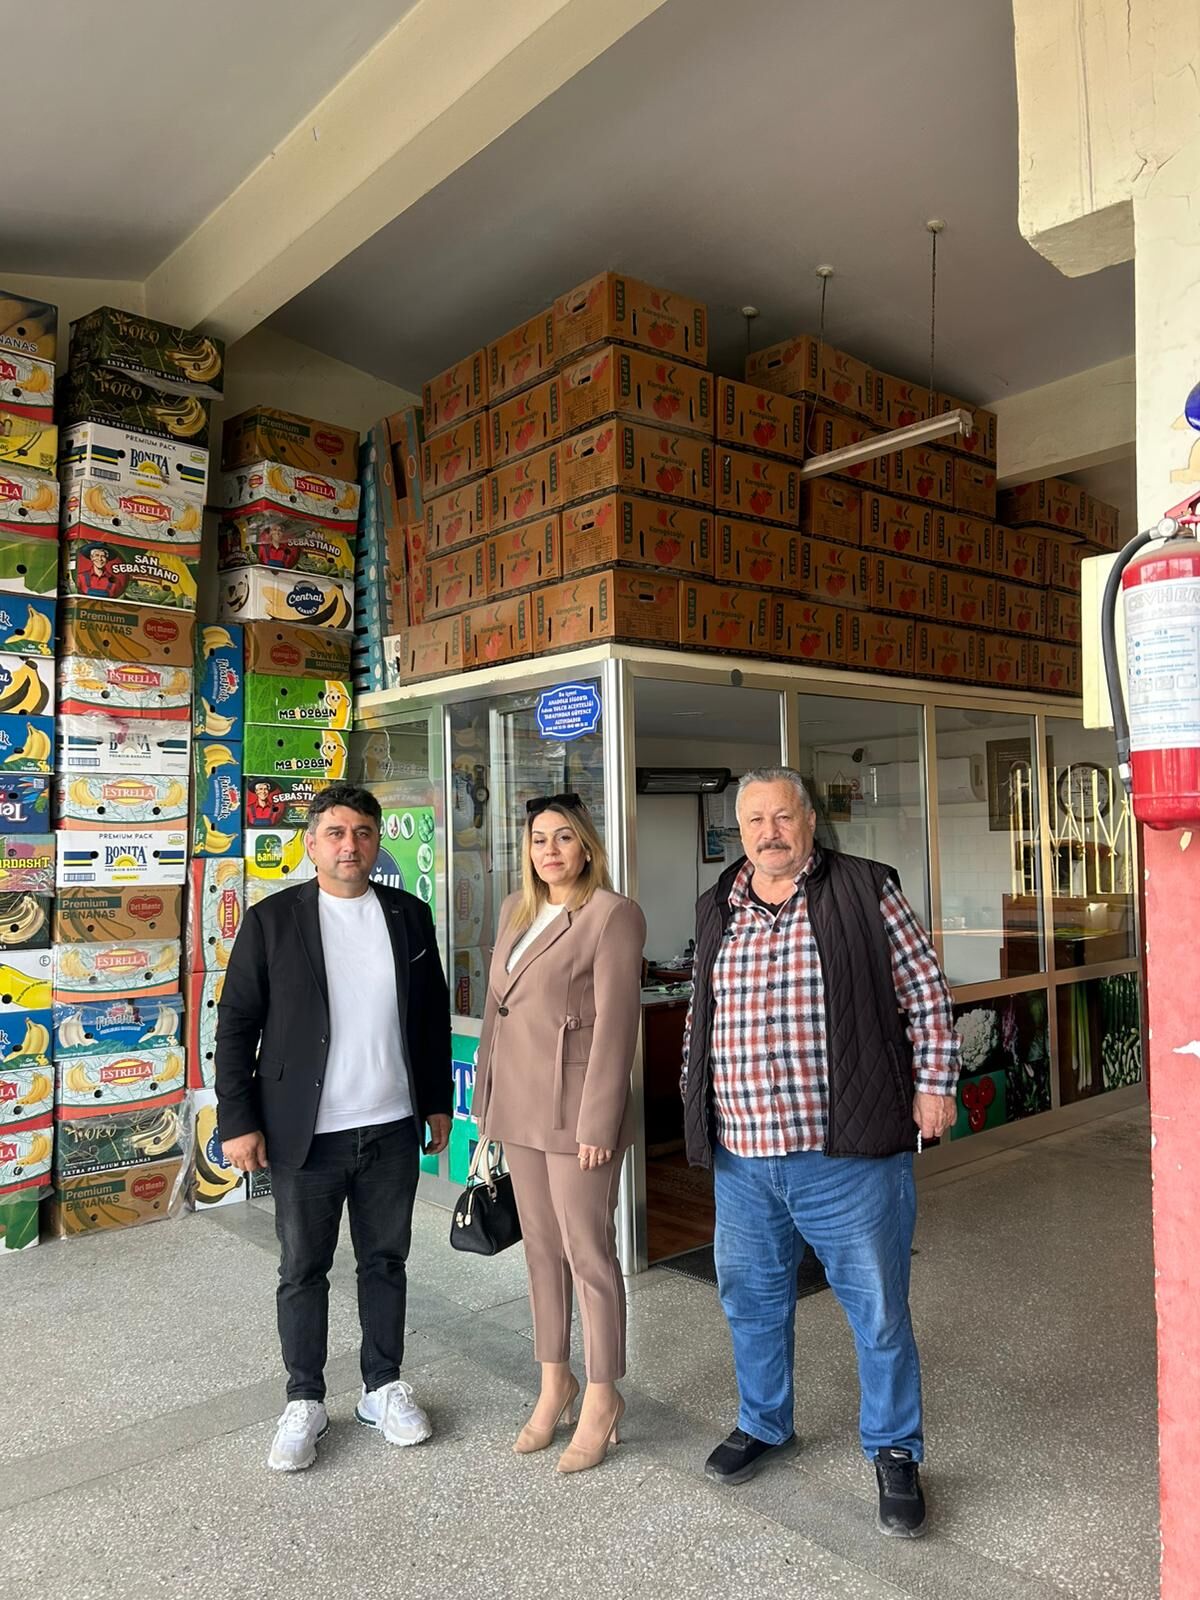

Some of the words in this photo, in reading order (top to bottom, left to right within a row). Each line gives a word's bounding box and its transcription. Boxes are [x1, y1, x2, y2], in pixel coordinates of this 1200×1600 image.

[261, 416, 300, 432] Premium
[126, 434, 158, 446] PREMIUM
[159, 443, 177, 451] PACK
[130, 449, 169, 476] BONITA
[296, 480, 335, 498] ESTRELLA
[121, 501, 169, 518] ESTRELLA
[305, 530, 324, 541] SAN
[287, 539, 341, 556] SEBASTIANO
[135, 555, 158, 566] SAN
[112, 565, 179, 583] SEBASTIANO
[288, 592, 323, 604] Central
[80, 611, 125, 623] Premium
[80, 622, 132, 635] BANANAS
[110, 671, 159, 685] ESTRELLA
[105, 788, 154, 797] ESTRELLA
[292, 784, 313, 792] SAN
[0, 803, 27, 821] Te
[0, 857, 50, 868] RDASHT
[105, 846, 147, 865] BONITA
[62, 899, 108, 909] Premium
[62, 909, 116, 920] BANANAS
[225, 892, 234, 937] ESTRELLA
[97, 955, 146, 966] ESTRELLA
[102, 1065, 152, 1079] ESTRELLA
[62, 1169, 85, 1177] EXTRA
[87, 1162, 119, 1172] PREMIUM
[121, 1157, 151, 1167] BANANAS
[66, 1184, 112, 1200] Premium
[66, 1194, 120, 1212] BANANAS
